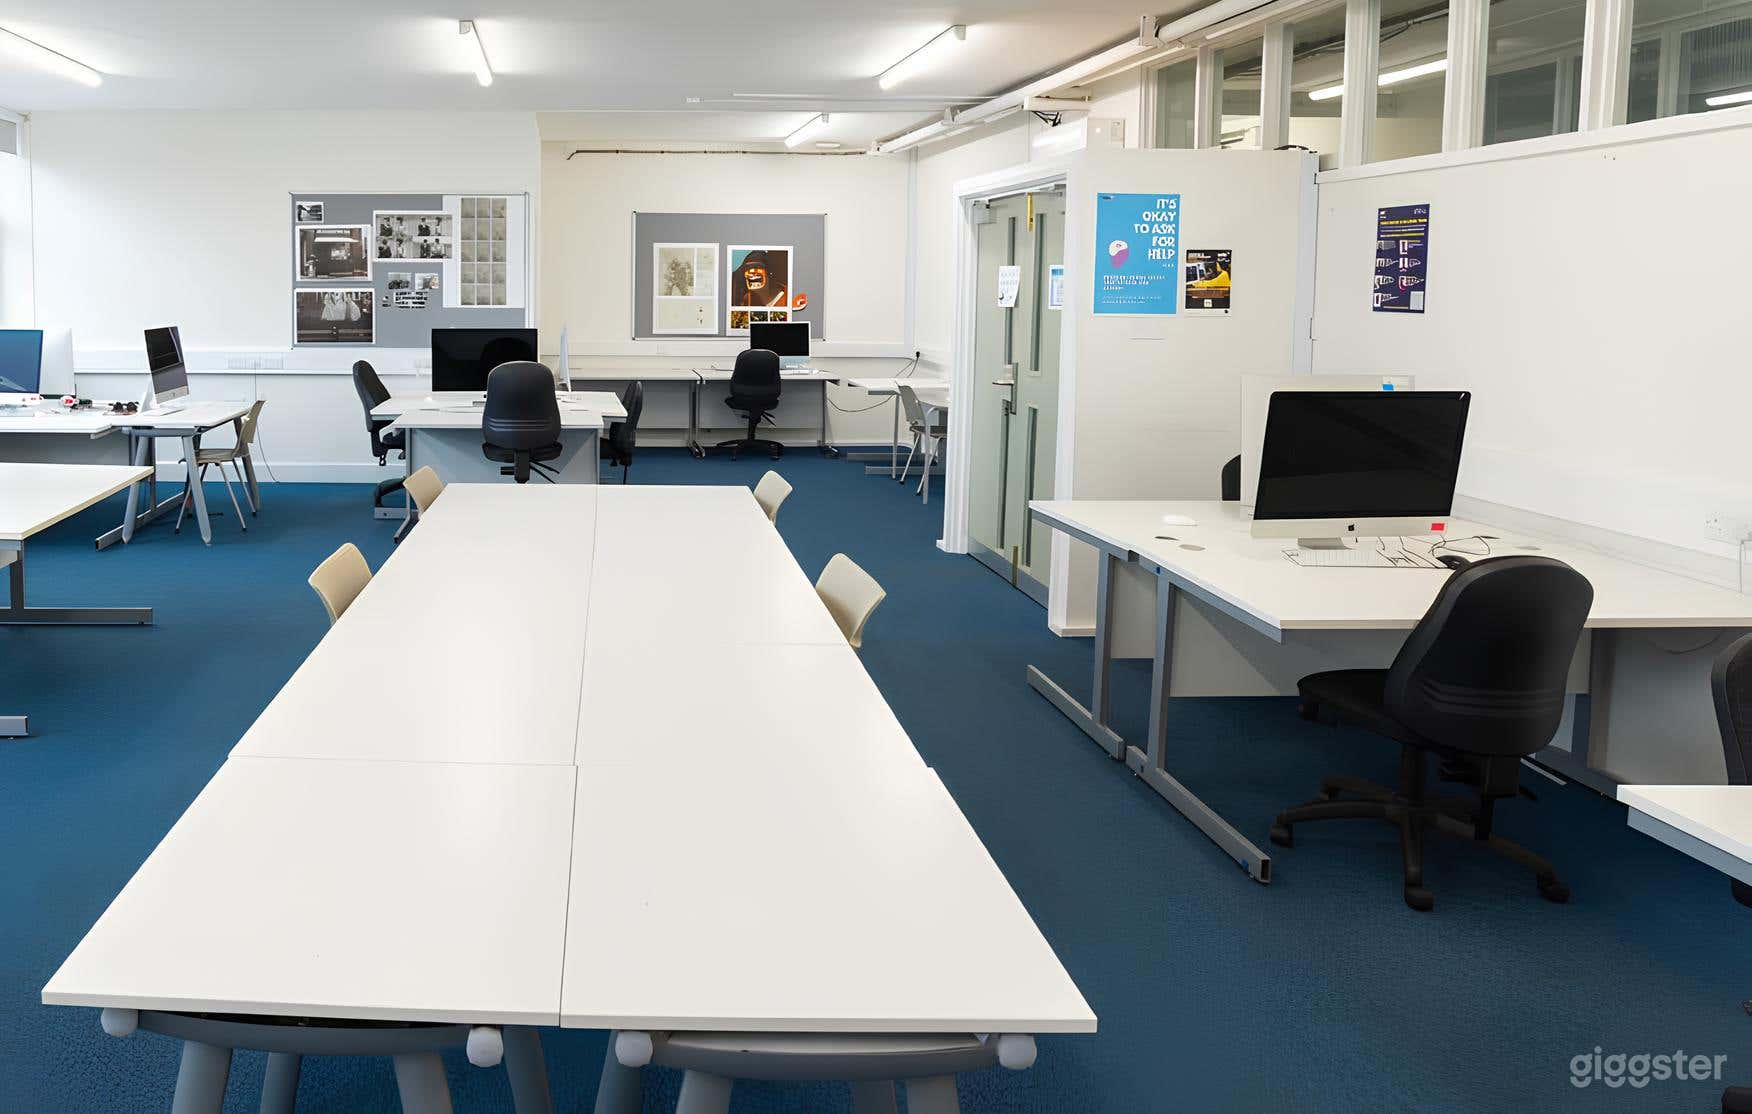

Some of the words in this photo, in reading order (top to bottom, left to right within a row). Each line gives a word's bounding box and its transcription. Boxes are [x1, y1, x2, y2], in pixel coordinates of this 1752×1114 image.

[1142, 212, 1176, 222] OKAY
[1134, 224, 1149, 234] TO
[1151, 224, 1176, 234] ASK
[1152, 236, 1175, 247] FOR
[1148, 249, 1175, 260] HELP
